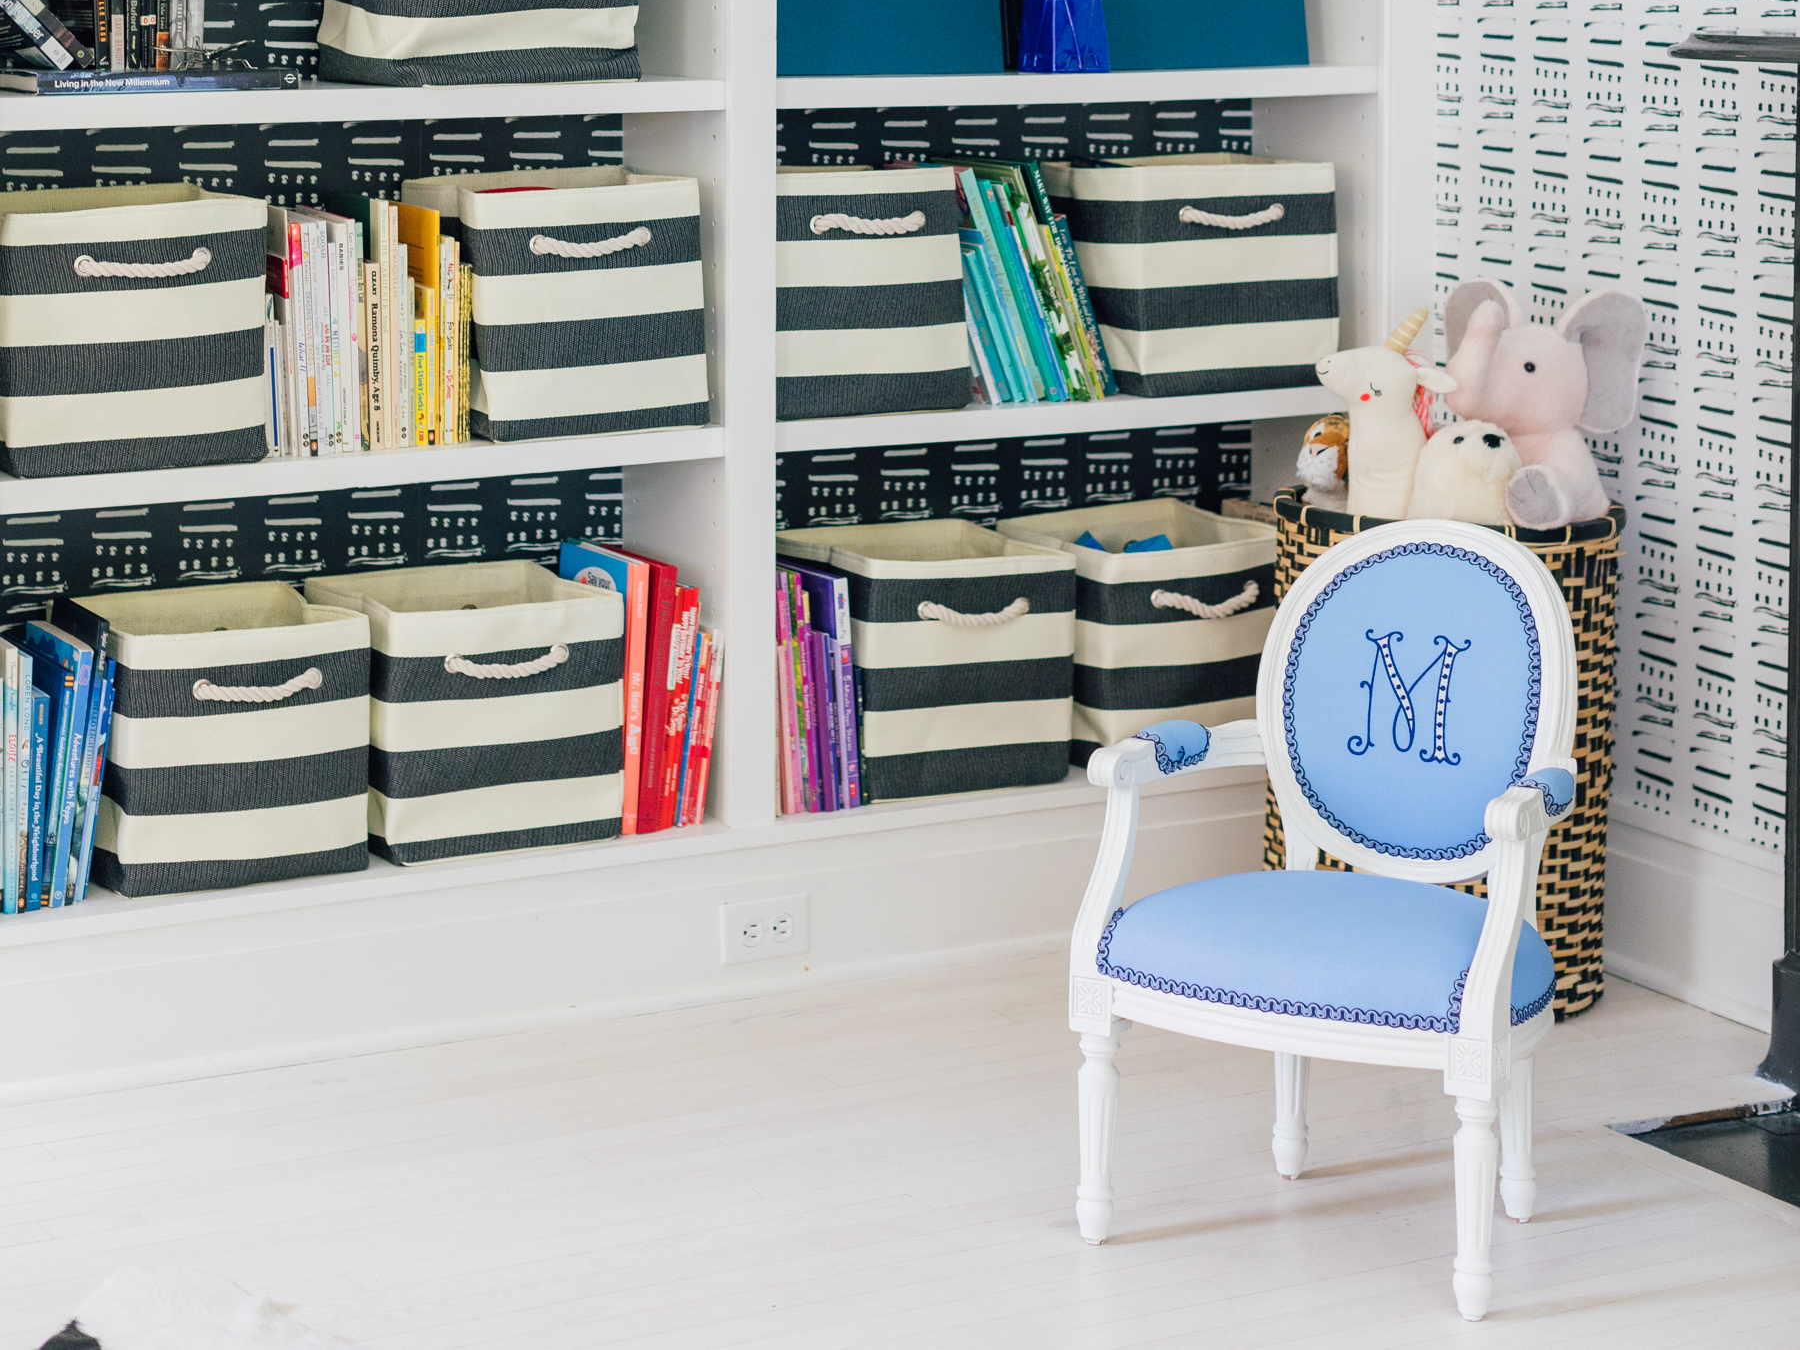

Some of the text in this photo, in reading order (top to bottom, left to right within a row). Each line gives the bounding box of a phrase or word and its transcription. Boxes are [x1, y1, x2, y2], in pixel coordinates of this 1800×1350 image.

[130, 0, 138, 31] Buford
[54, 80, 79, 88] Living
[125, 78, 169, 86] Millennium
[1033, 170, 1058, 234] MAKE WAY FOR
[371, 303, 379, 343] Ramona
[332, 331, 340, 365] NEITHER
[371, 345, 380, 384] Quimby,
[371, 386, 380, 403] Age
[632, 672, 641, 689] Mr.
[630, 691, 640, 720] Bear's
[1347, 628, 1471, 765] M
[8, 734, 16, 762] ELOISE
[35, 733, 43, 743] A
[35, 744, 43, 783] Beautiful
[62, 733, 82, 824] Adventures with Peppa
[33, 785, 42, 799] Day
[33, 802, 41, 811] in
[31, 824, 40, 881] Neighborhood
